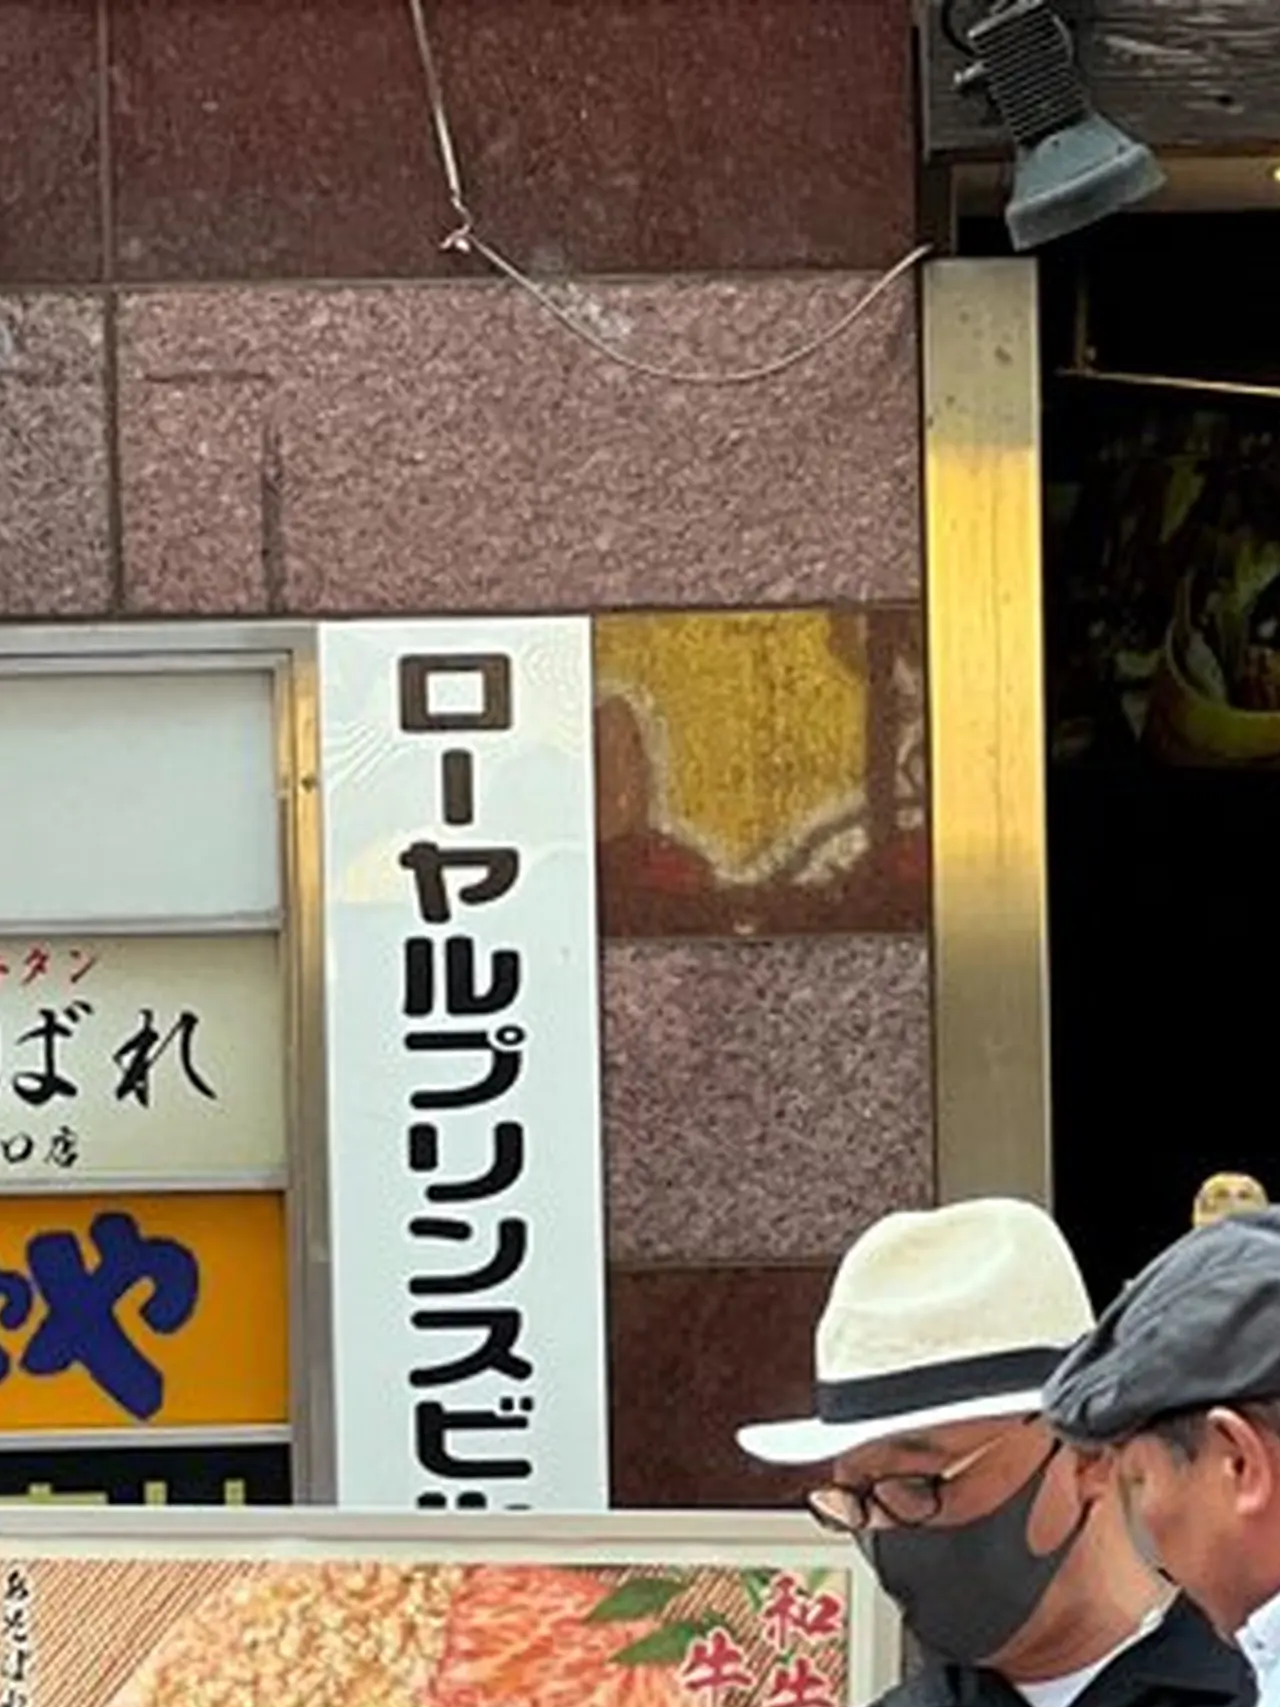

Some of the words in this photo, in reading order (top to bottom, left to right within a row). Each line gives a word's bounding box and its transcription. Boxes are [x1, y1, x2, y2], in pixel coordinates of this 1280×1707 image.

[398, 652, 534, 1510] ローヤルプリンスビ
